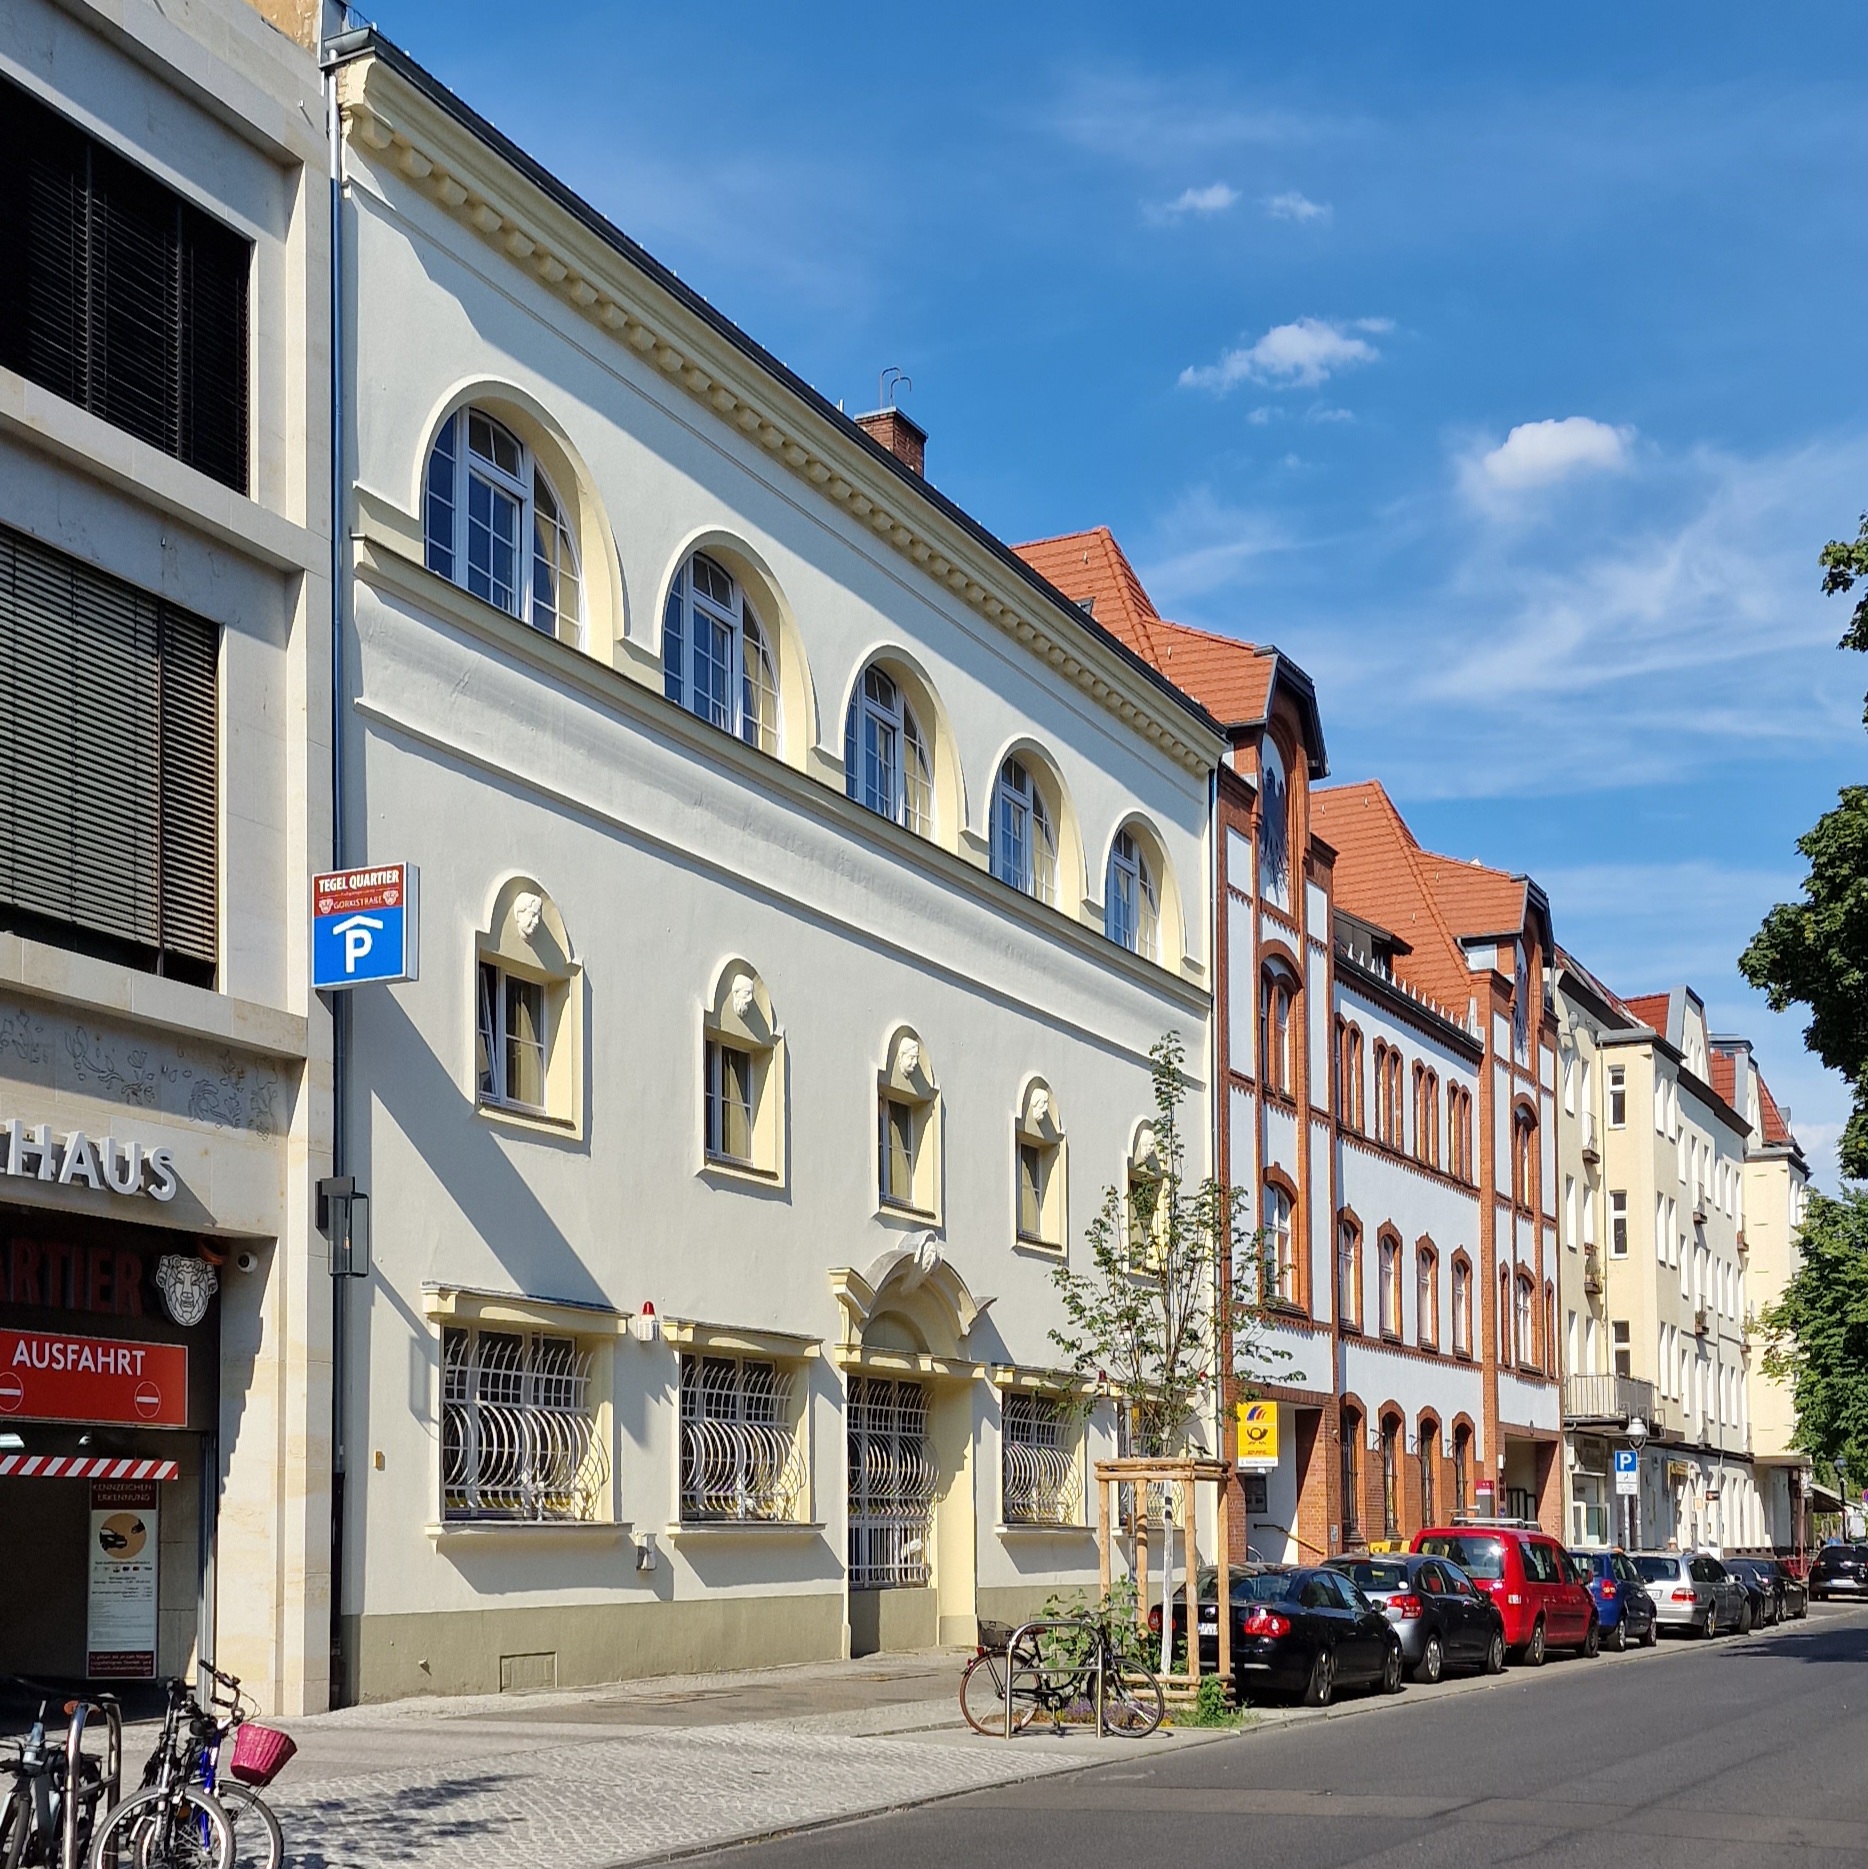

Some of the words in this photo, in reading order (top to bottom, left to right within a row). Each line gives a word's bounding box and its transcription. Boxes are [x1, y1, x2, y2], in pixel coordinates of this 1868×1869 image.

[319, 877, 348, 893] TEGEL
[349, 870, 399, 889] QUARTIER
[345, 929, 372, 974] P
[11, 1339, 146, 1377] AUSFAHRT
[1620, 1453, 1632, 1470] P
